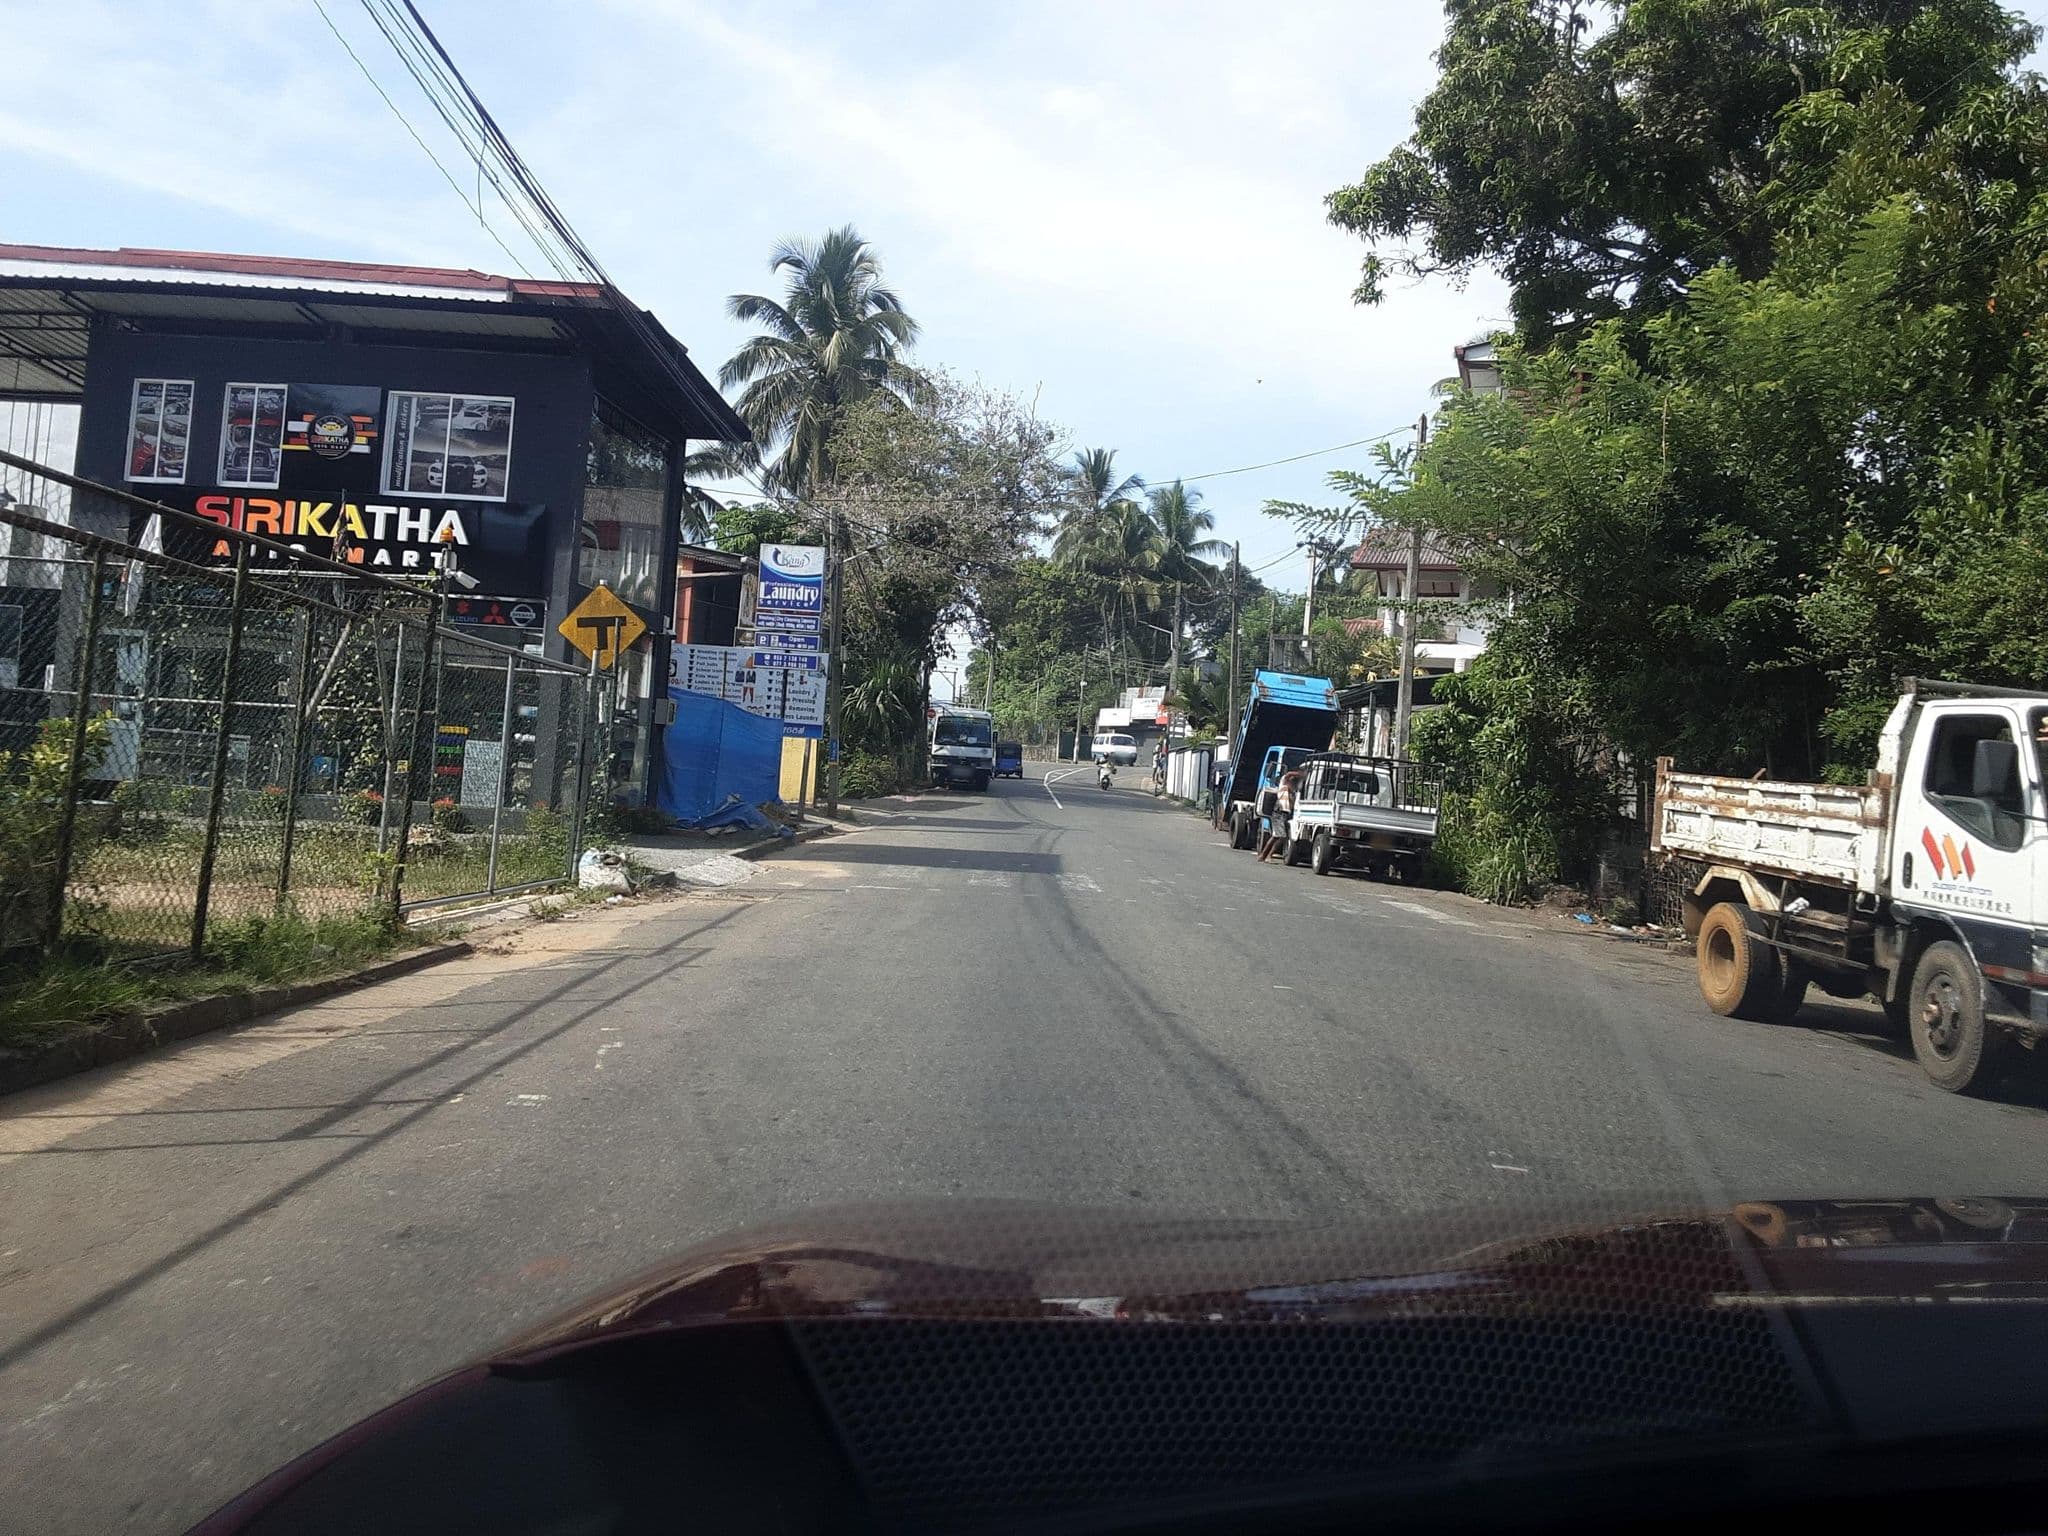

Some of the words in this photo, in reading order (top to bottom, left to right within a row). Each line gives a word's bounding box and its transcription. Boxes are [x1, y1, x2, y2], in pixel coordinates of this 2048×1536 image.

[195, 495, 470, 545] SIRIKATHA
[760, 581, 819, 606] Laundry
[760, 599, 809, 607] Service
